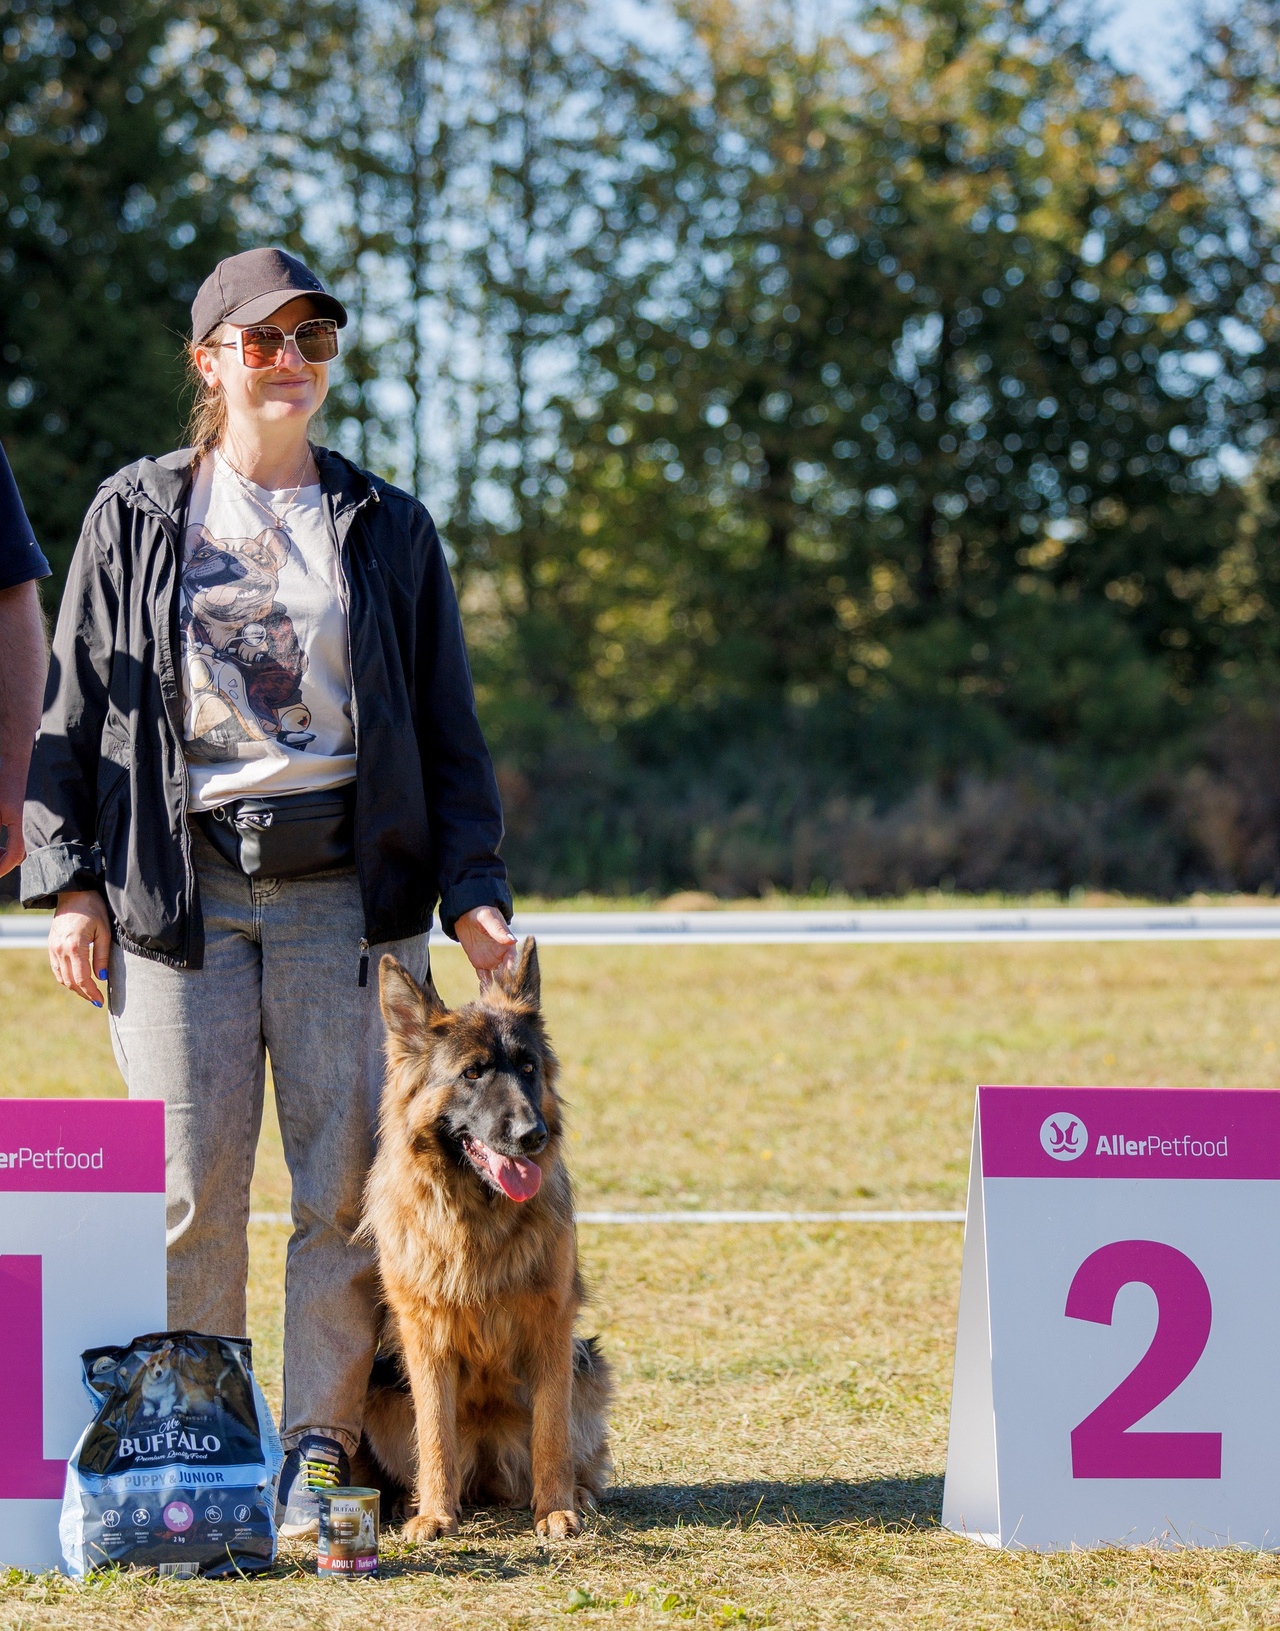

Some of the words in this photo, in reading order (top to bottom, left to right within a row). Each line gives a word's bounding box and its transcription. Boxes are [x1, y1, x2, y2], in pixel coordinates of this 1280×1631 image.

[1095, 1135, 1228, 1157] AllerPetfood
[1064, 1239, 1222, 1479] 2
[158, 1418, 182, 1434] Mr.
[119, 1430, 221, 1458] BUFFALO
[135, 1454, 166, 1462] Premium
[124, 1474, 166, 1488] PUPPY
[169, 1475, 177, 1484] &
[178, 1471, 225, 1483] JUNIOR
[178, 1536, 186, 1544] kg
[331, 1559, 354, 1569] ADULT
[358, 1559, 373, 1568] Turkey
